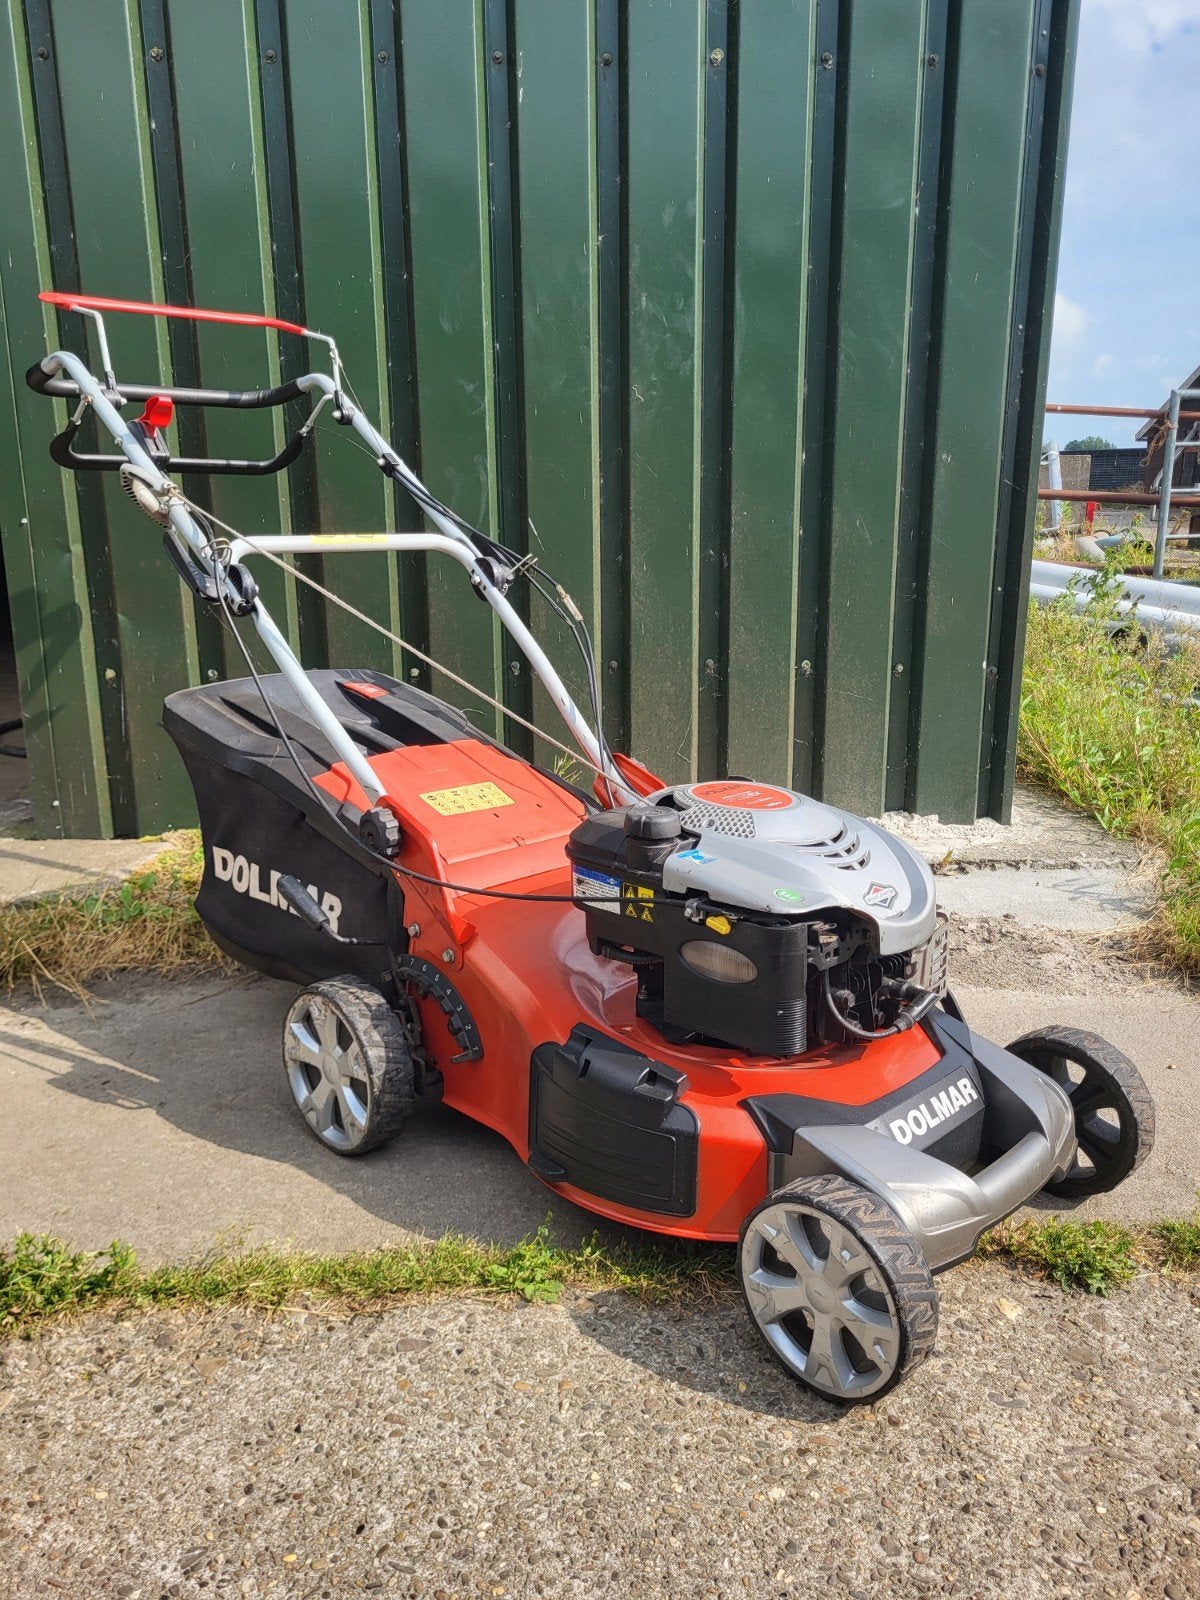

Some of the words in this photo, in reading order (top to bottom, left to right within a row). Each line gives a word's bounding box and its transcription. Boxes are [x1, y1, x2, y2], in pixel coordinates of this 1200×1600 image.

[409, 957, 415, 966] 7
[422, 964, 427, 972] 6
[434, 974, 440, 982] 5
[456, 1004, 462, 1012] 3
[889, 1078, 978, 1145] DOLMAR
